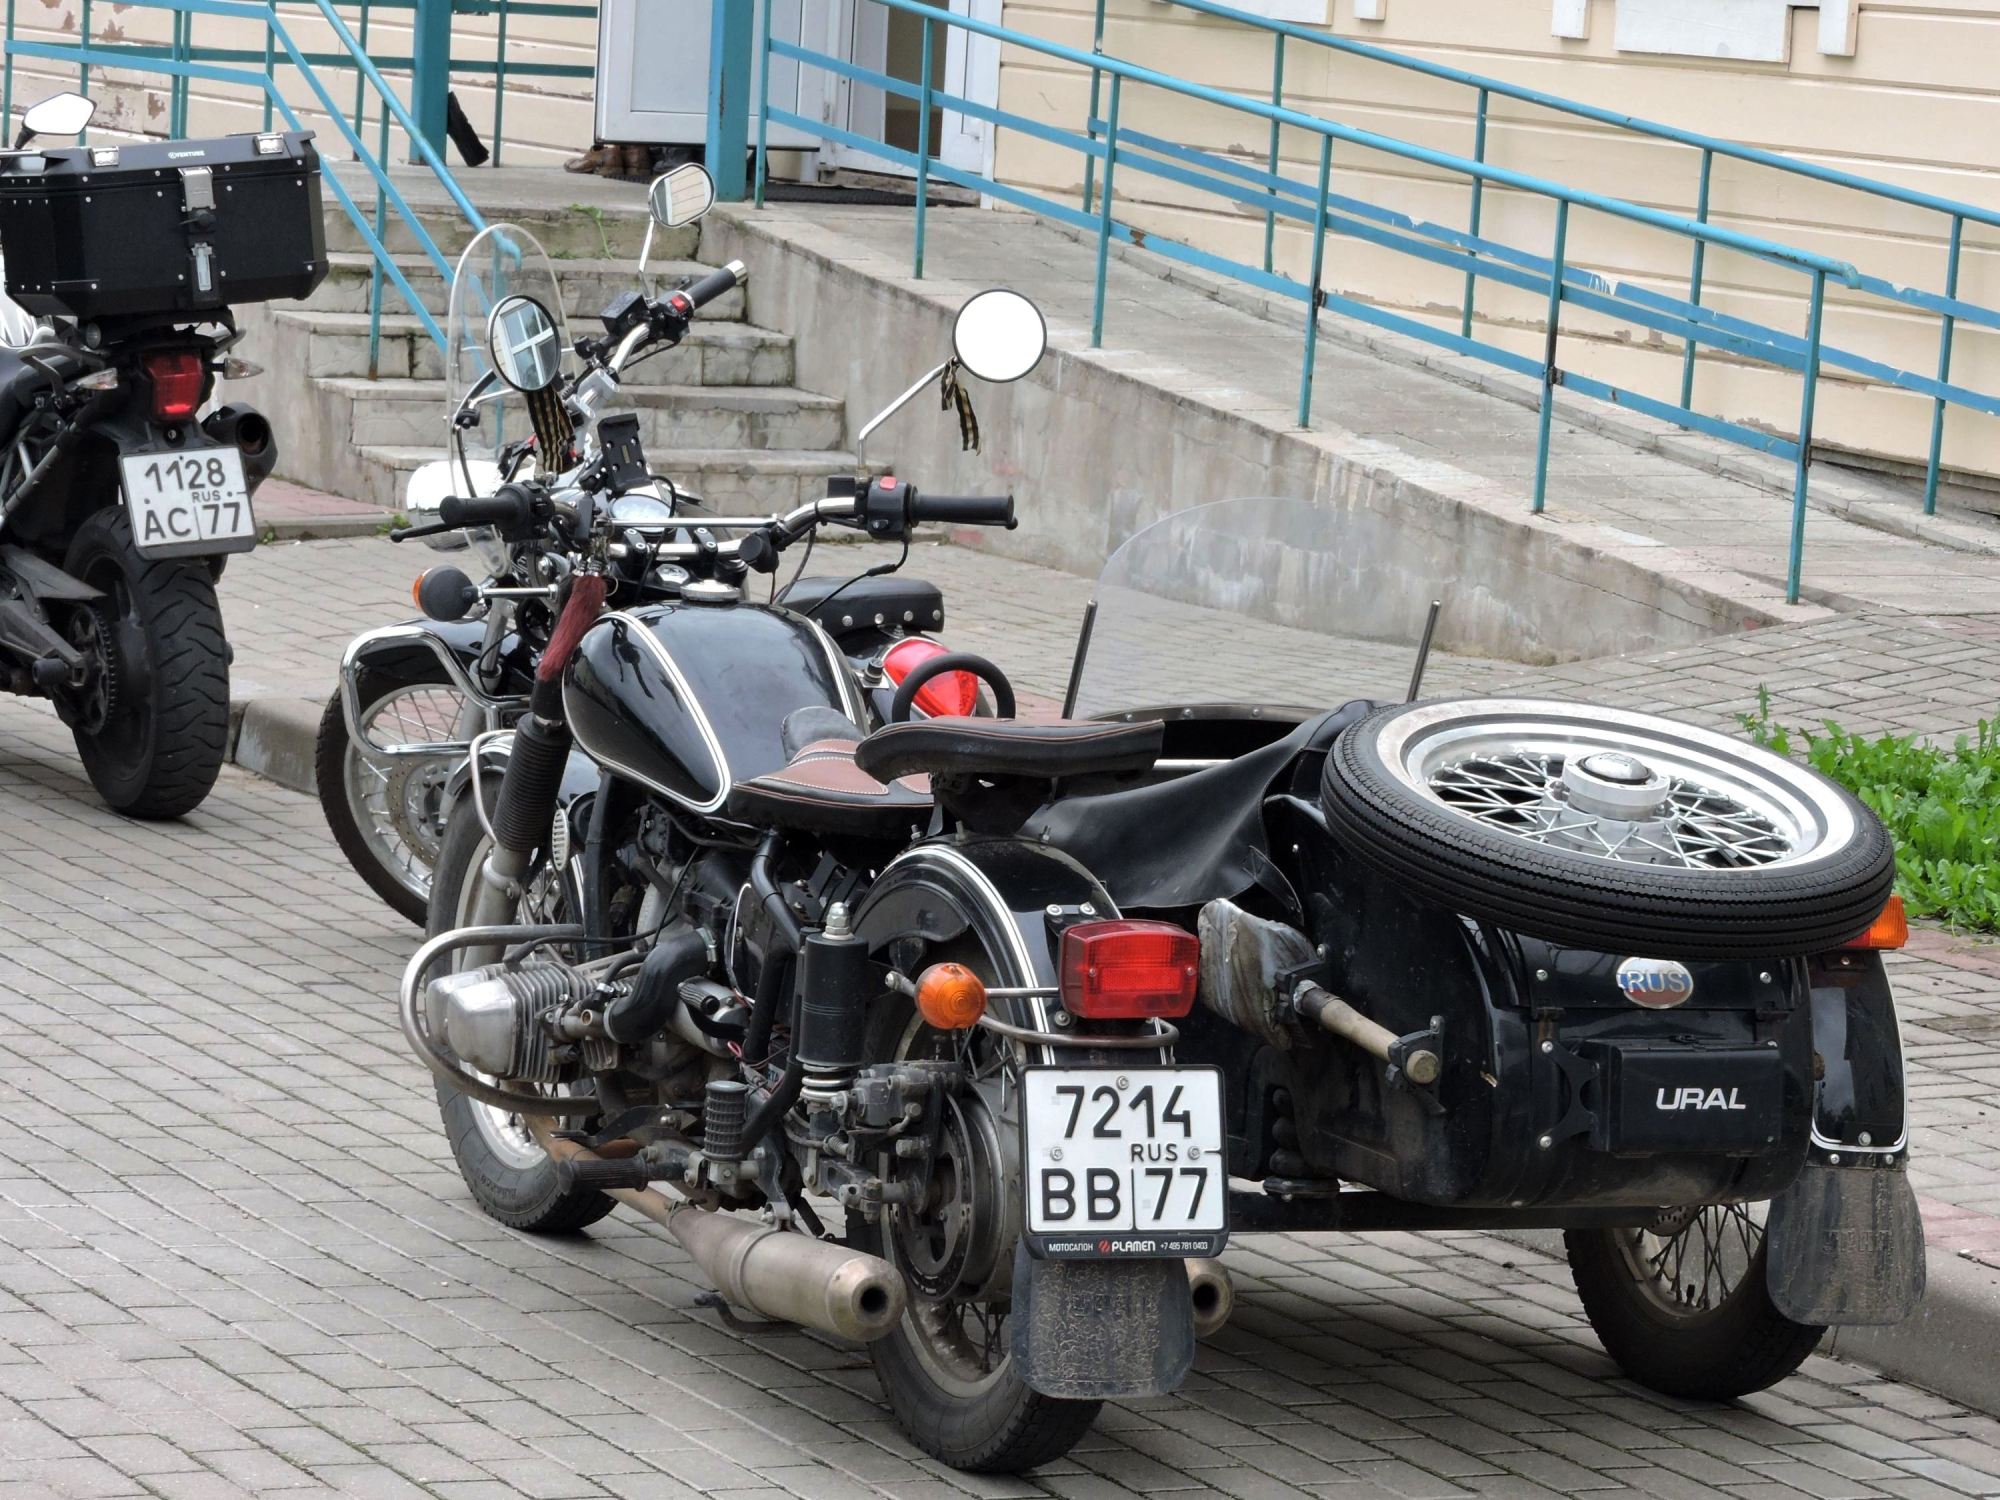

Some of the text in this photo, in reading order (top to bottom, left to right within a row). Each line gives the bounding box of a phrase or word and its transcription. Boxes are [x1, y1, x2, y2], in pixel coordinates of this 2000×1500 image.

[145, 457, 226, 492] 1128
[191, 490, 222, 503] RUS
[144, 501, 241, 541] AC 77
[1626, 969, 1688, 993] RUS
[1655, 1087, 1747, 1111] URAL
[1055, 1085, 1192, 1139] 7214
[1130, 1143, 1179, 1163] RUS
[1041, 1167, 1208, 1222] BB 77
[1048, 1243, 1094, 1252] МОТОСАЛОН
[1111, 1240, 1156, 1252] PLAMEN
